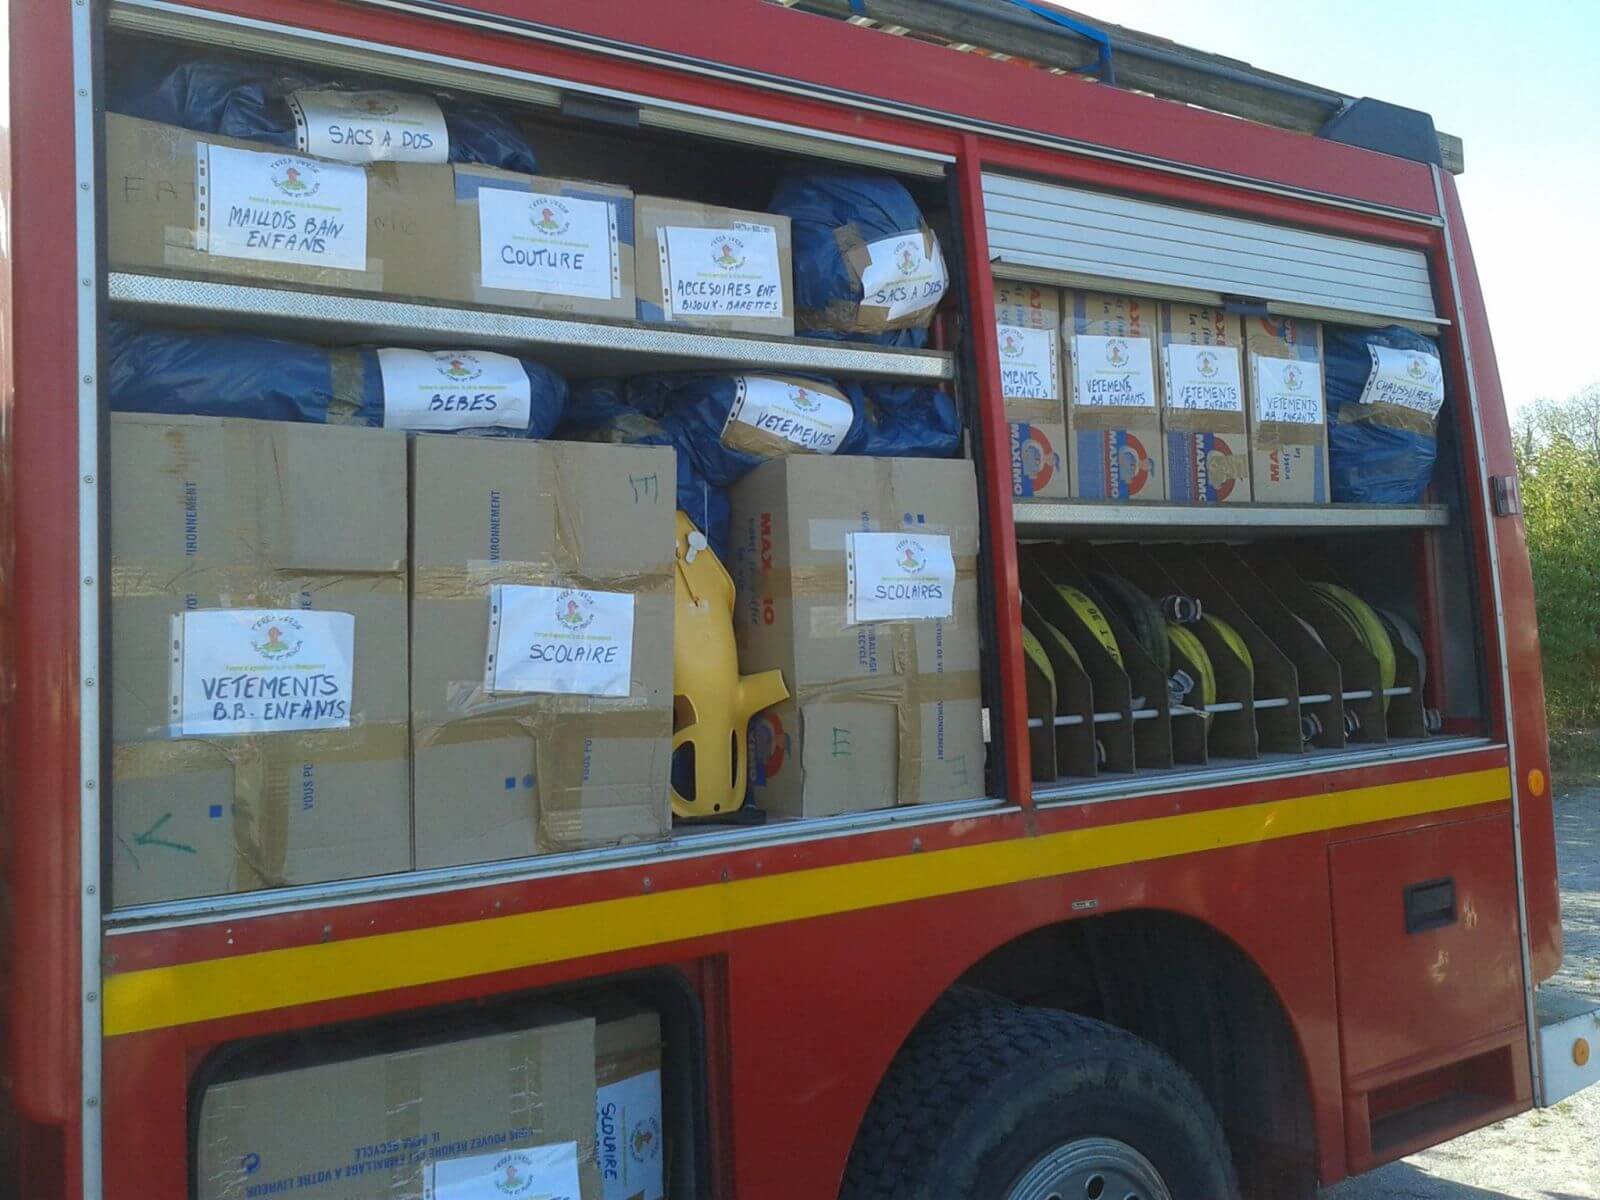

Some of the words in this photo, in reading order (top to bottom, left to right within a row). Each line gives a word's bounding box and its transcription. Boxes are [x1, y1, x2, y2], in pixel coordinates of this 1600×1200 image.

[328, 125, 374, 146] SACS
[382, 128, 392, 147] A
[402, 130, 434, 149] DOS
[228, 205, 298, 231] MAILLOTS
[304, 216, 345, 239] BAIN
[246, 230, 327, 254] ENFANTS
[501, 244, 585, 270] COUTURE
[677, 280, 751, 297] ACCESOIRES
[756, 284, 777, 297] ENF
[875, 287, 907, 304] SACS
[911, 286, 918, 300] A
[923, 280, 942, 298] DOS
[726, 300, 778, 311] BARETTES
[1003, 370, 1042, 386] MENTS
[1086, 374, 1132, 393] VETEMENTS
[428, 393, 498, 411] BEBES
[1178, 384, 1237, 400] VETEMENTS
[1376, 379, 1433, 402] CHAUSSURES
[1266, 396, 1318, 412] VETEMENTS
[755, 411, 836, 446] VETEMENTS
[1011, 422, 1023, 496] MAXIMO
[1108, 429, 1120, 499] MAXIMO
[186, 481, 198, 556] IRONNEMENT
[490, 490, 501, 563] VIRONNEMENT
[875, 583, 943, 600] SCOLAIRES
[529, 643, 619, 665] SCOLAIRE
[202, 673, 339, 700] VETEMENTS
[264, 699, 346, 720] ENFANTS
